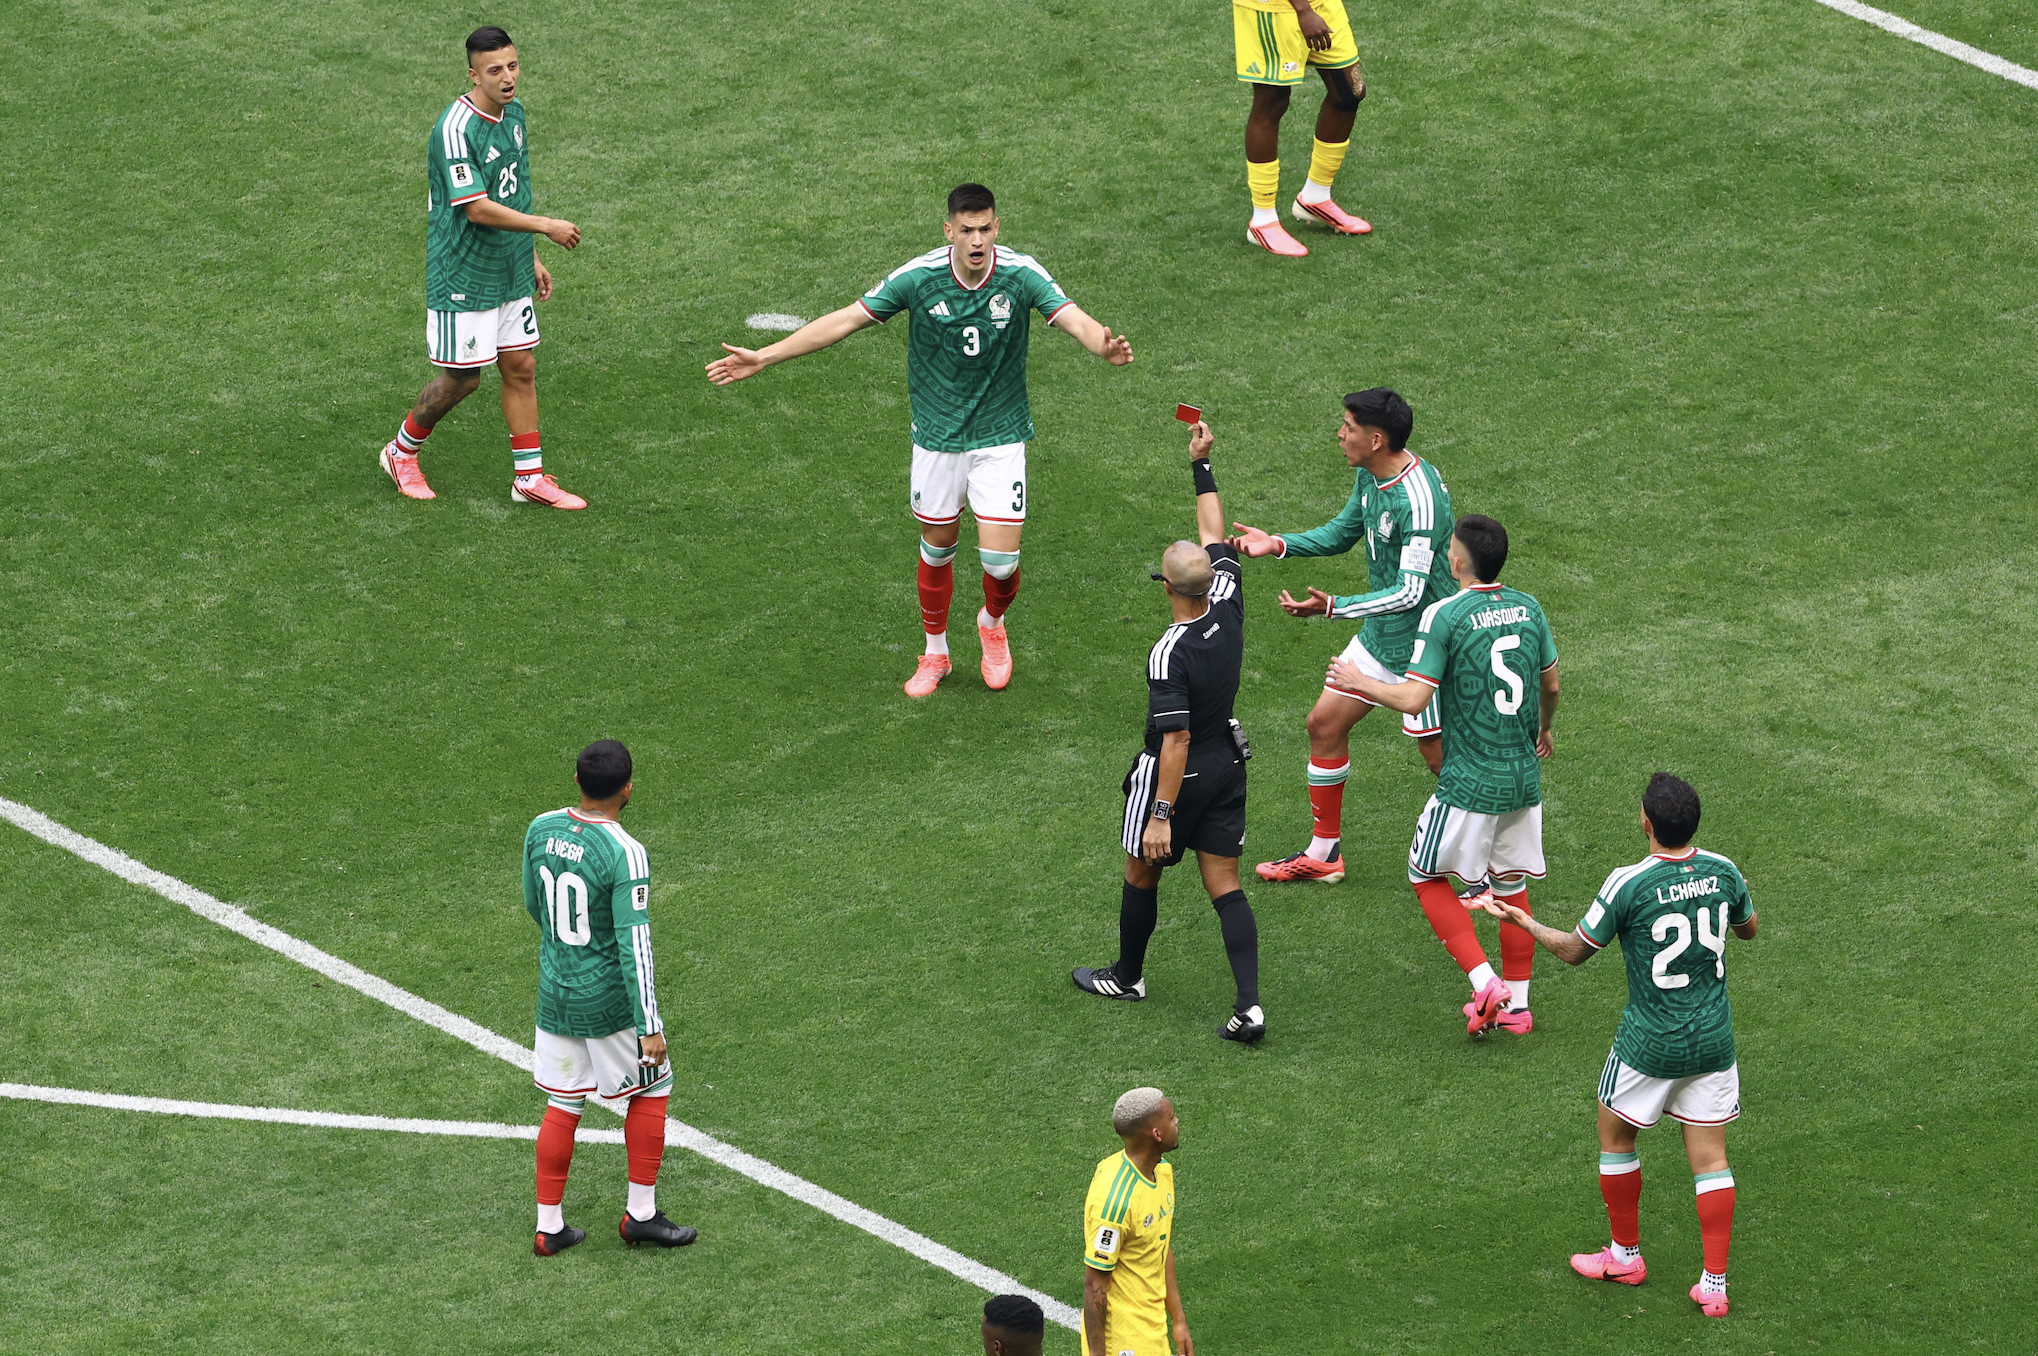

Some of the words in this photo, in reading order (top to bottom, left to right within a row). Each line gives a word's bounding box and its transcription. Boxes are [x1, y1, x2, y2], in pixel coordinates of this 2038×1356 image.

[498, 161, 518, 199] 25
[962, 326, 981, 357] 3
[1012, 481, 1023, 512] 3
[1470, 606, 1531, 630] J.VÁSQUEZ
[1490, 634, 1524, 716] 5
[545, 837, 584, 863] A.VEGA
[539, 865, 591, 946] 10
[1656, 876, 1720, 904] L.CHÁVEZ
[1651, 901, 1729, 990] 24
